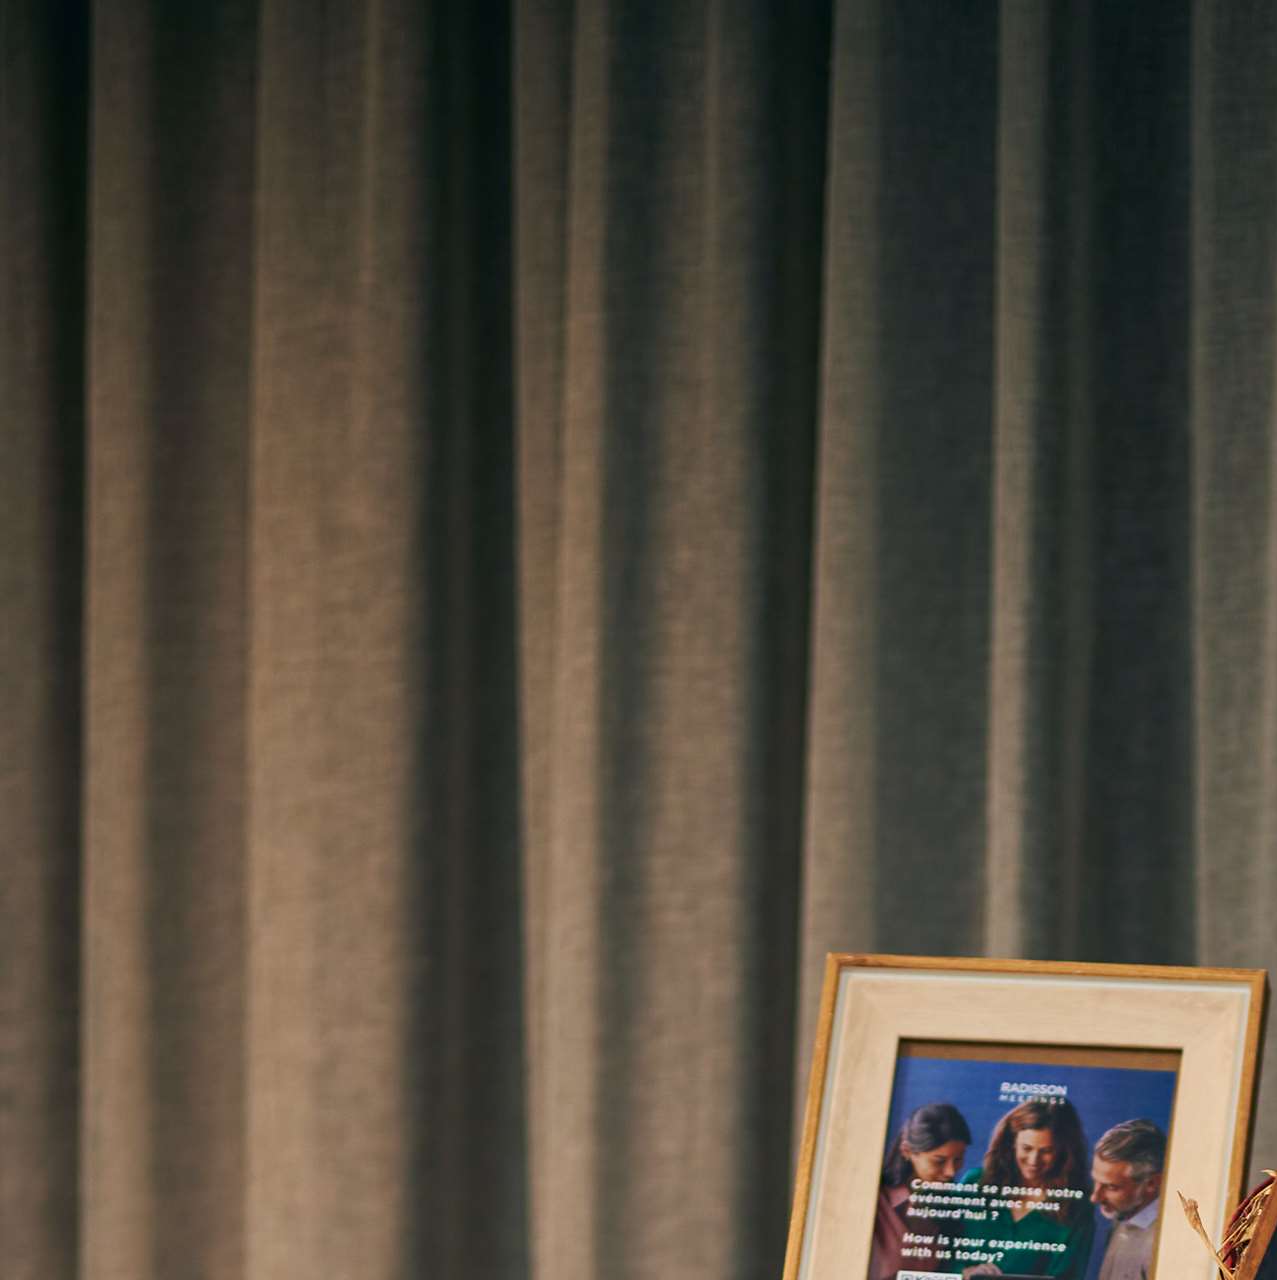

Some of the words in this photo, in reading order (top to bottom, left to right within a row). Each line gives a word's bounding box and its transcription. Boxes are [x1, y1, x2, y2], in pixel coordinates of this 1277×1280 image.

[1001, 1081, 1067, 1096] RADISSON
[911, 1178, 978, 1192] Comment
[982, 1184, 998, 1194] se
[1002, 1185, 1042, 1197] passe
[1046, 1188, 1084, 1199] votre
[908, 1192, 986, 1206] événement
[990, 1198, 1022, 1209] avec
[1026, 1201, 1060, 1211] nous
[906, 1206, 987, 1220] aujourd'hui
[991, 1211, 999, 1221] ?
[902, 1232, 934, 1245] How
[937, 1234, 949, 1245] is
[953, 1237, 986, 1248] your
[988, 1239, 1067, 1253] experience
[901, 1246, 932, 1258] with
[935, 1249, 951, 1259] us
[955, 1248, 1004, 1263] today?
